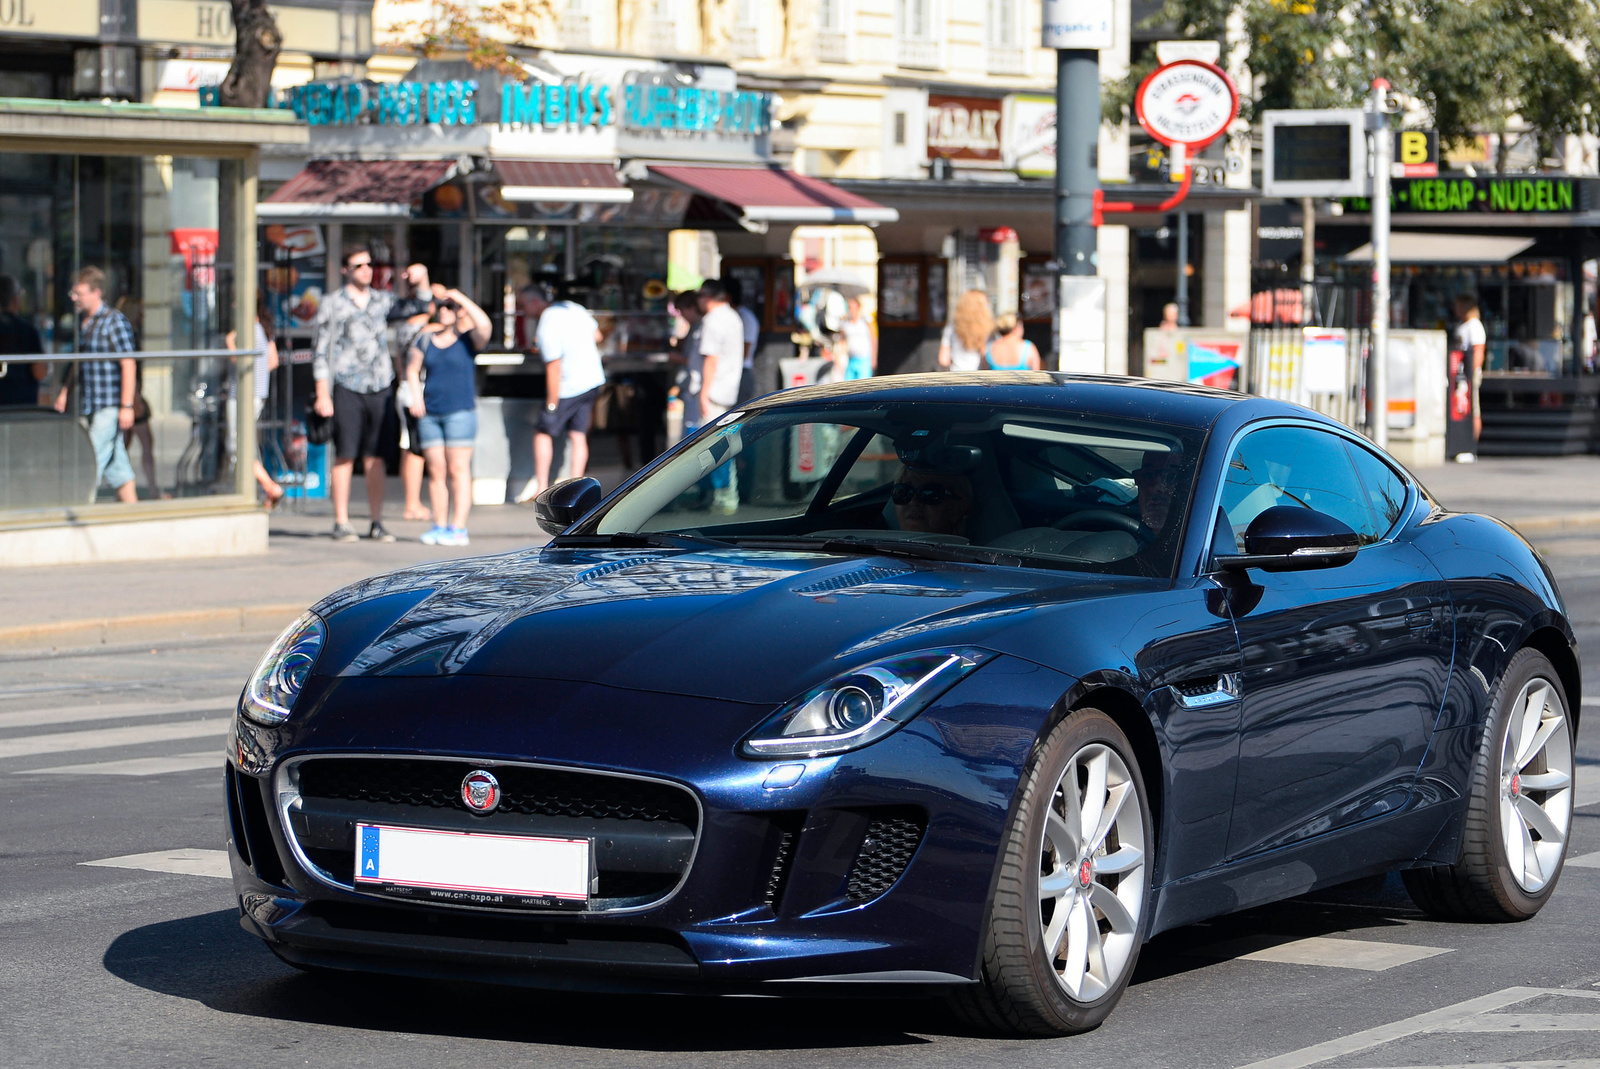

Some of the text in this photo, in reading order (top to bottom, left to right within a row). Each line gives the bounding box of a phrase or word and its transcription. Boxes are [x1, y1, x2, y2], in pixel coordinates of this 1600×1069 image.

[500, 83, 612, 127] IMBISS
[927, 106, 1001, 149] TABAK
[1401, 131, 1428, 164] B
[1409, 180, 1475, 211] KEBAP
[1490, 179, 1573, 211] NUDELN
[365, 858, 375, 871] A
[385, 886, 551, 906] HARTBERG www.car-expo.at HARTBERG
